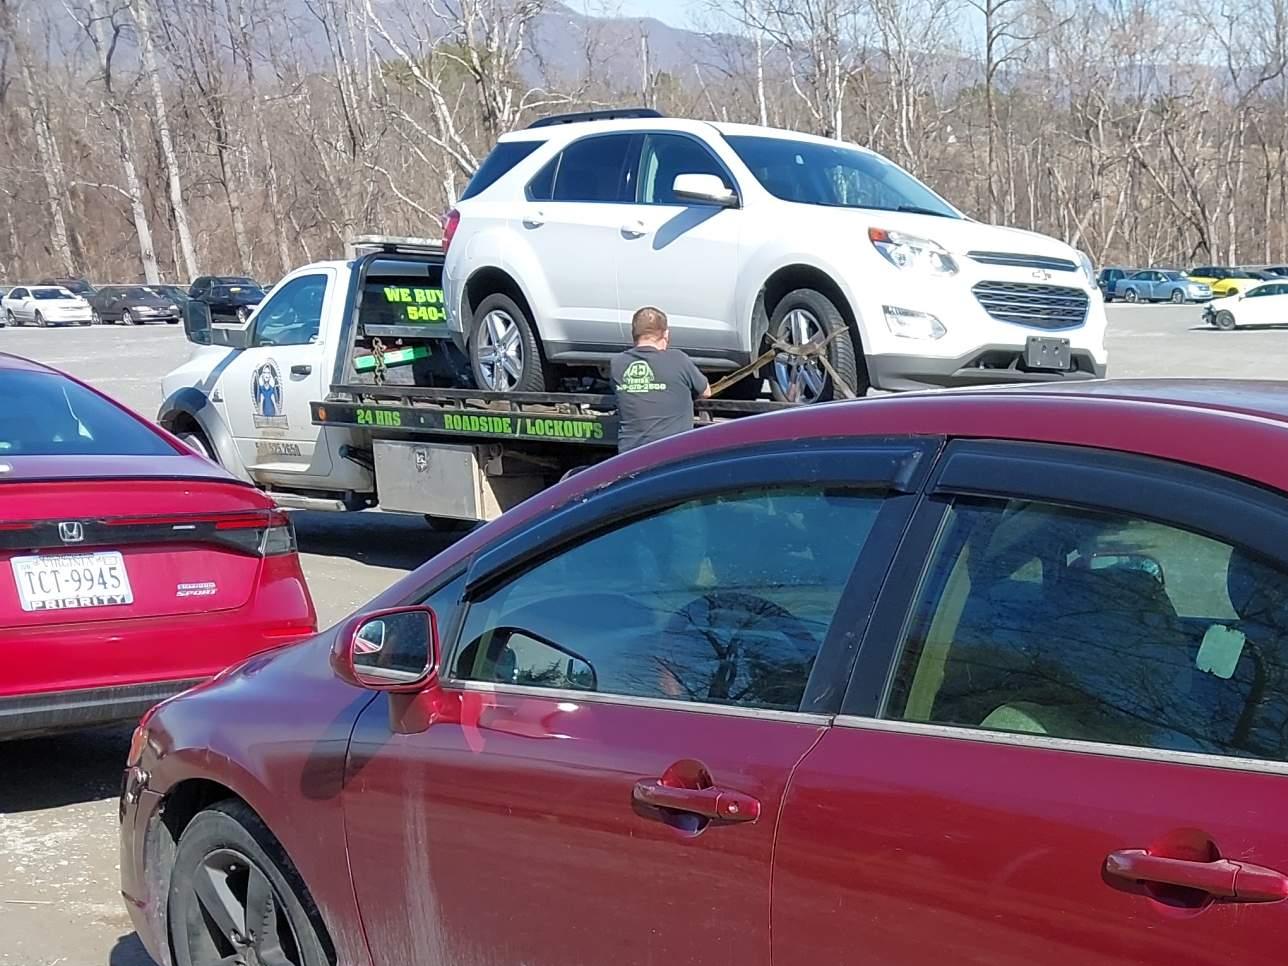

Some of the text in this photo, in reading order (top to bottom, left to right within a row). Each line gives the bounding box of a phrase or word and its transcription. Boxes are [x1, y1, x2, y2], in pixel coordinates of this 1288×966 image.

[384, 288, 412, 302] WE
[356, 409, 374, 424] 24
[444, 414, 513, 434] ROADSIDE
[525, 418, 604, 439] LOCKOUTS
[24, 567, 121, 595] TCT-9945
[30, 595, 126, 611] PRIORITY
